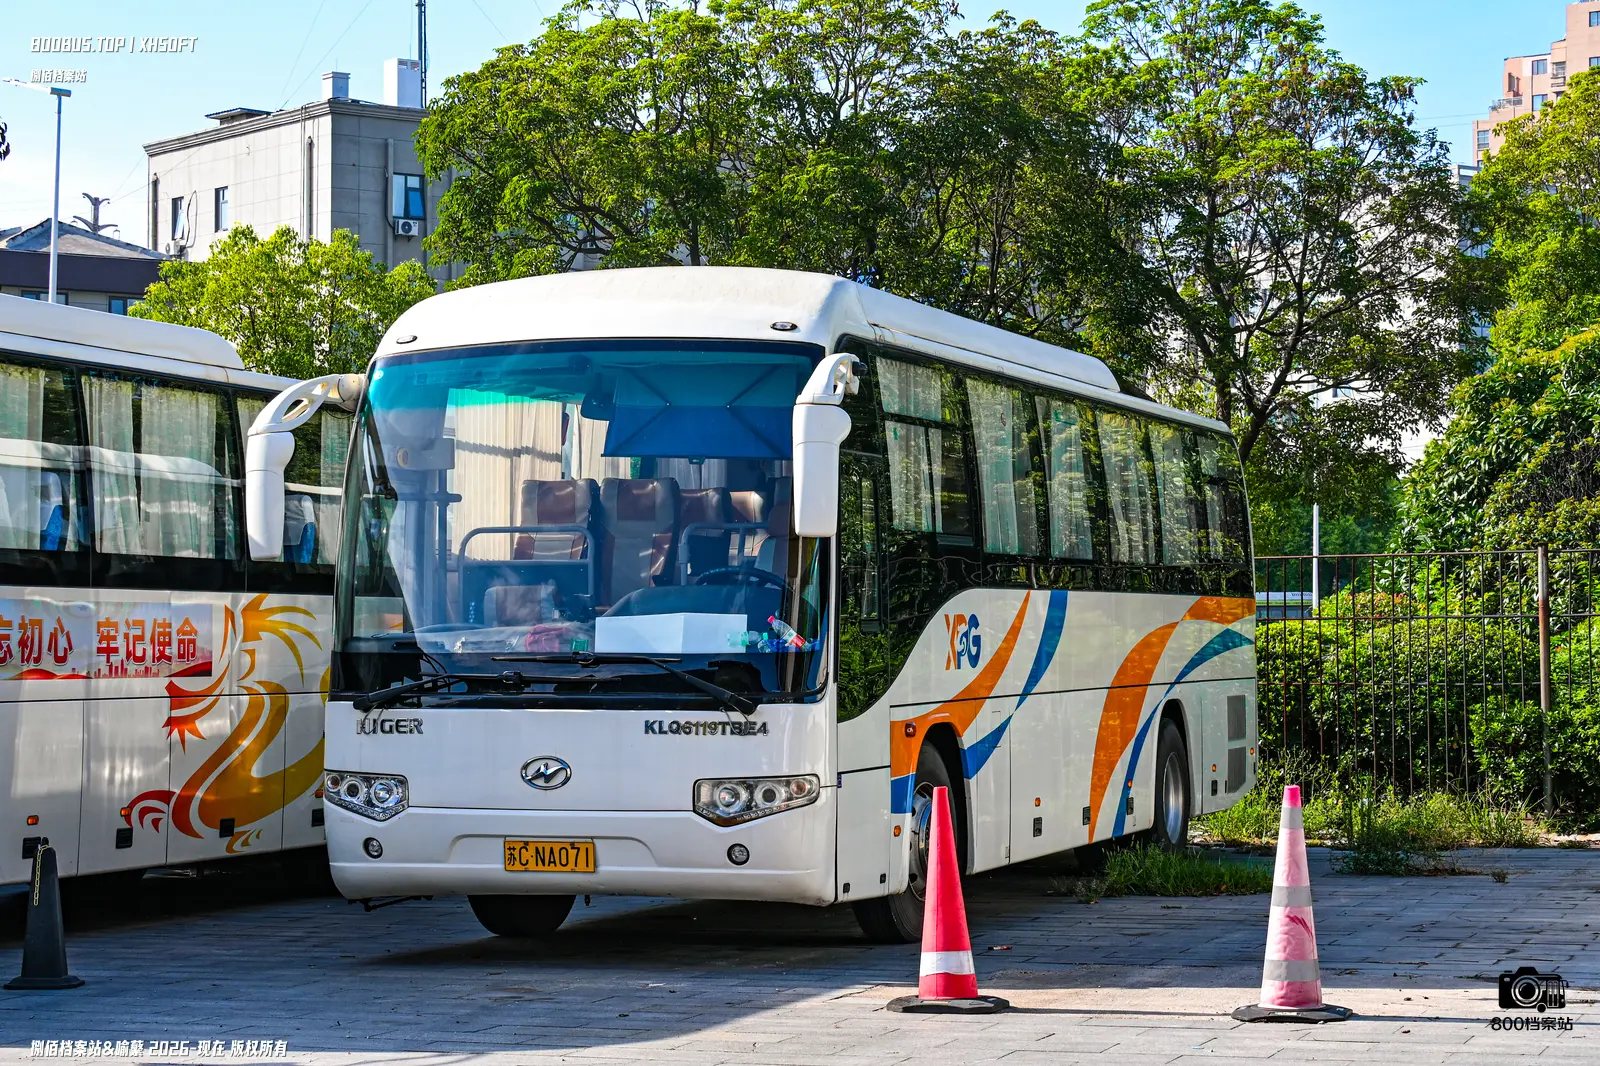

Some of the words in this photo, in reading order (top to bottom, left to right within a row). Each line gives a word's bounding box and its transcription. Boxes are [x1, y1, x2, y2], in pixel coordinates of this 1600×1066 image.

[96, 616, 199, 665] 牢记使命
[944, 613, 981, 670] XPG
